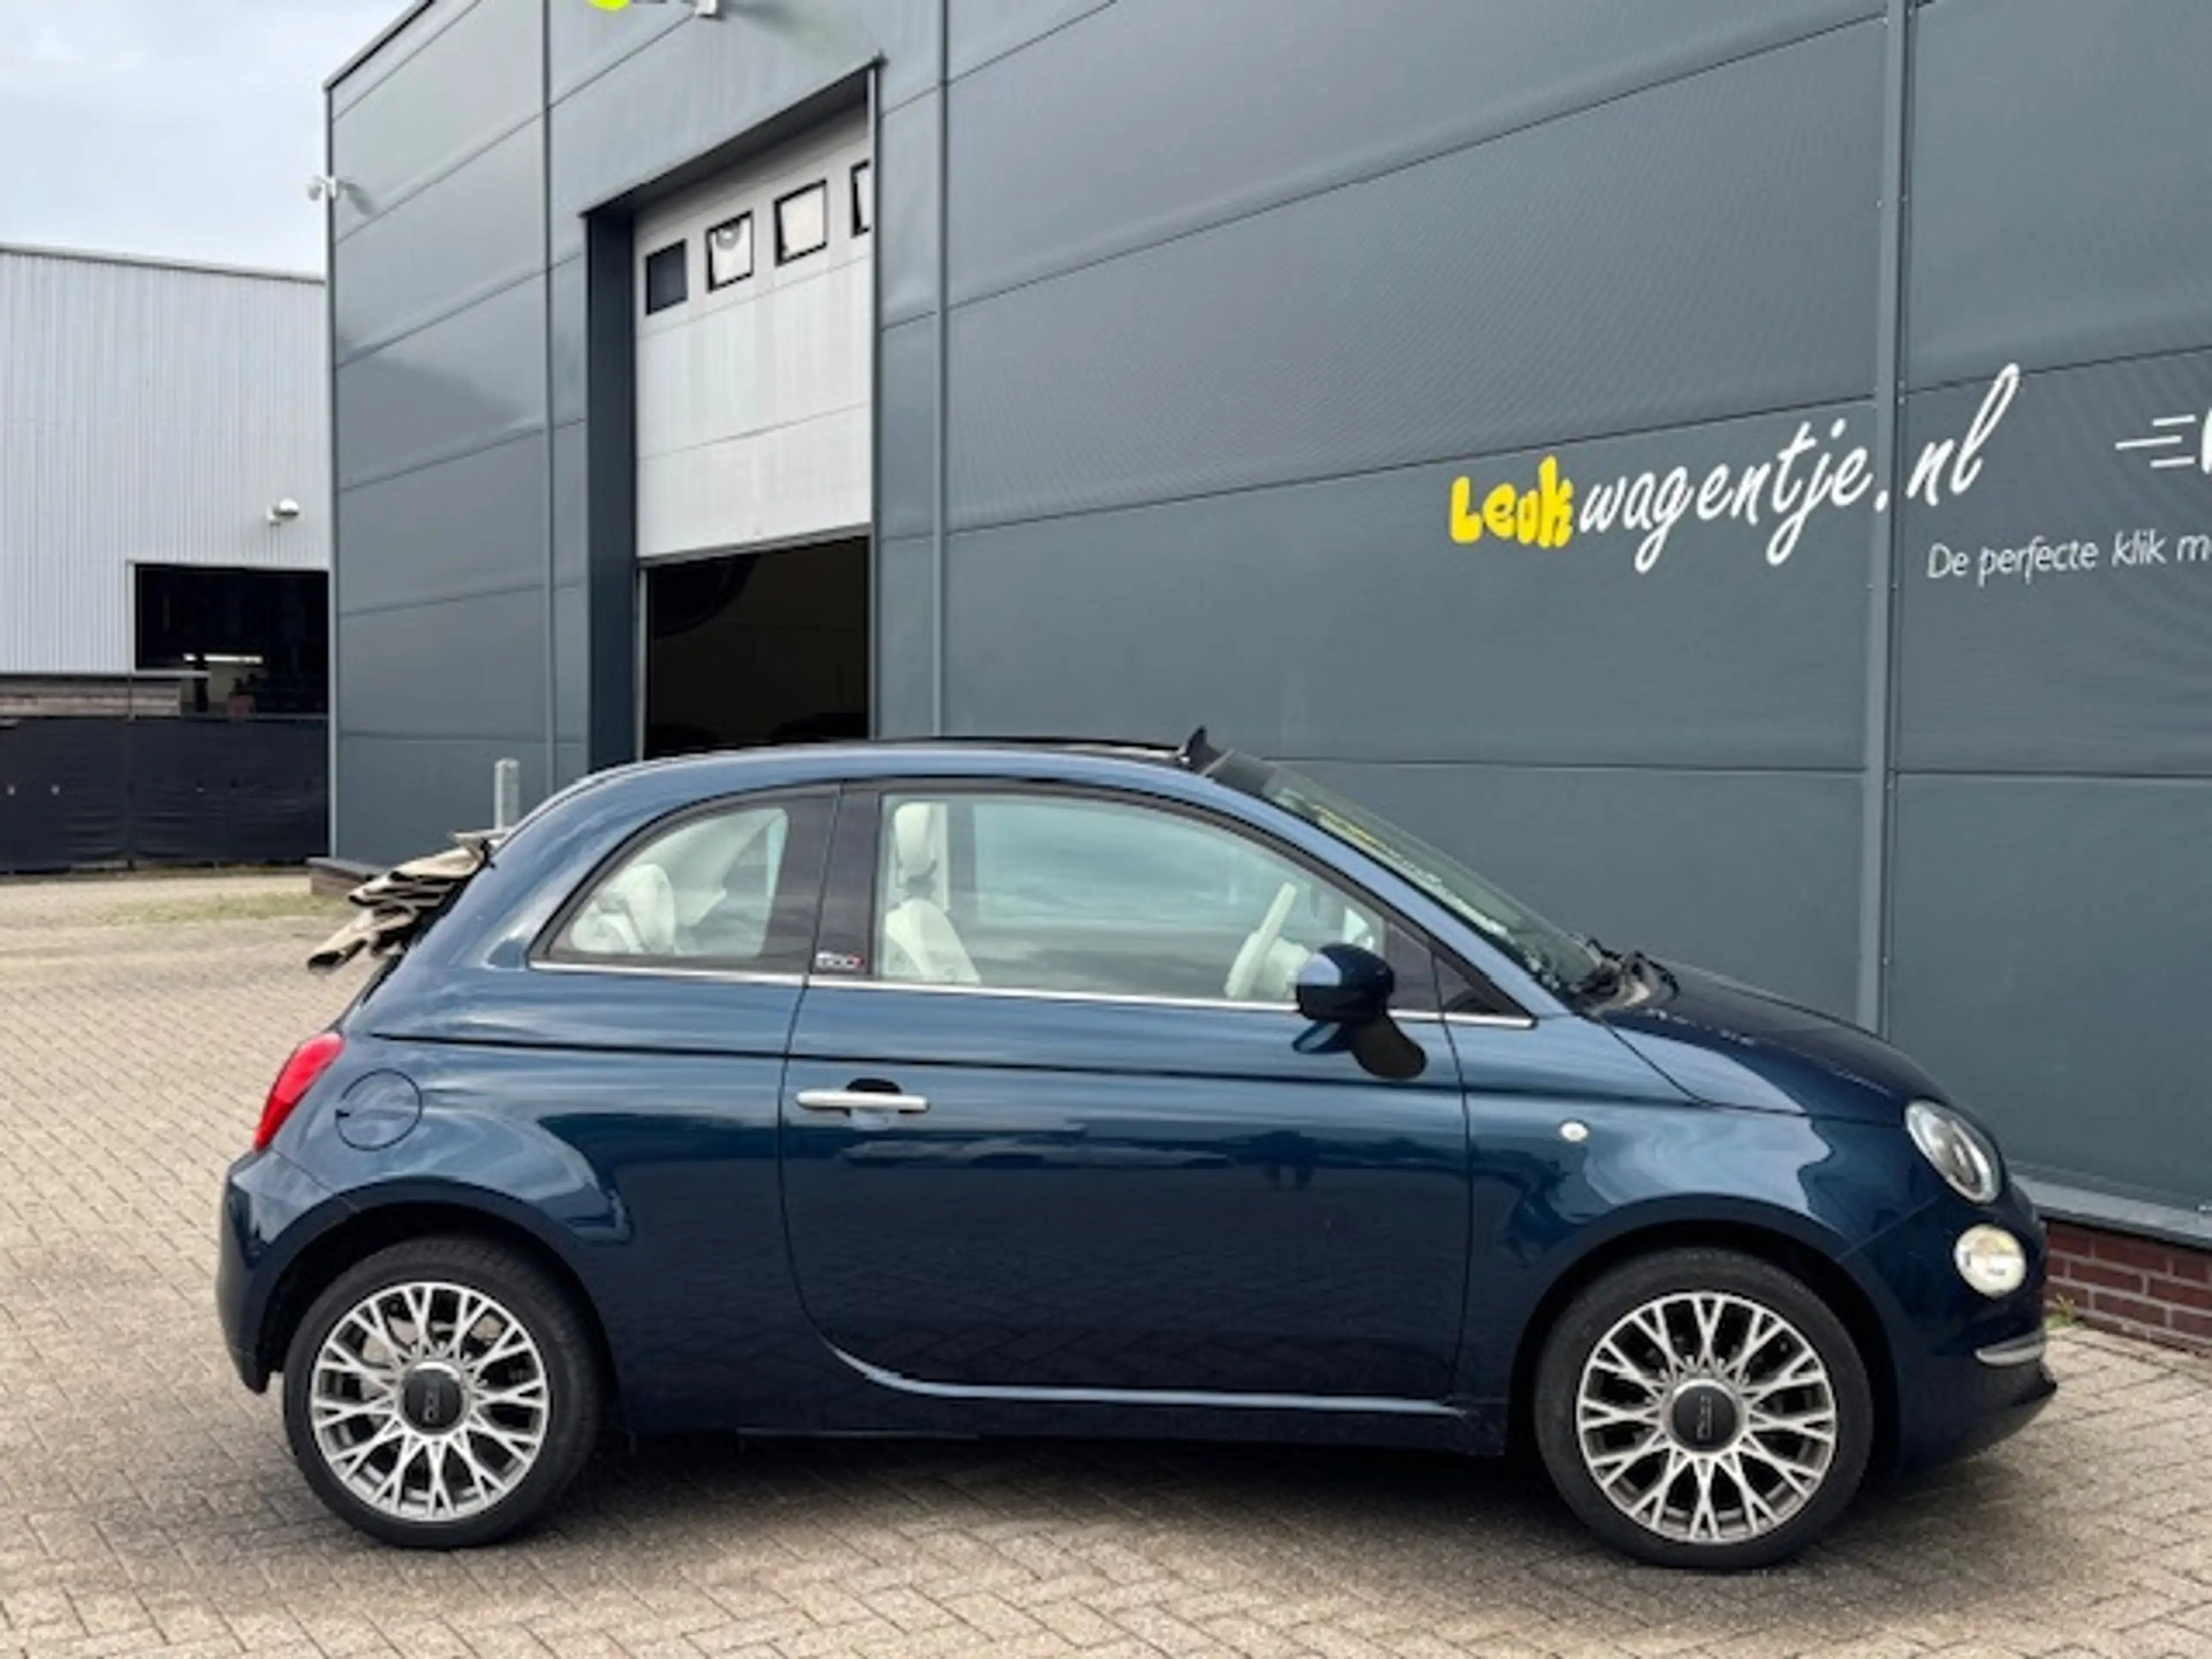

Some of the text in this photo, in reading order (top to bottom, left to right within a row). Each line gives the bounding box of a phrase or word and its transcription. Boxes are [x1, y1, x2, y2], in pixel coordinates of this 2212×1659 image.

[1927, 528, 2212, 587] De perfecte klik m
